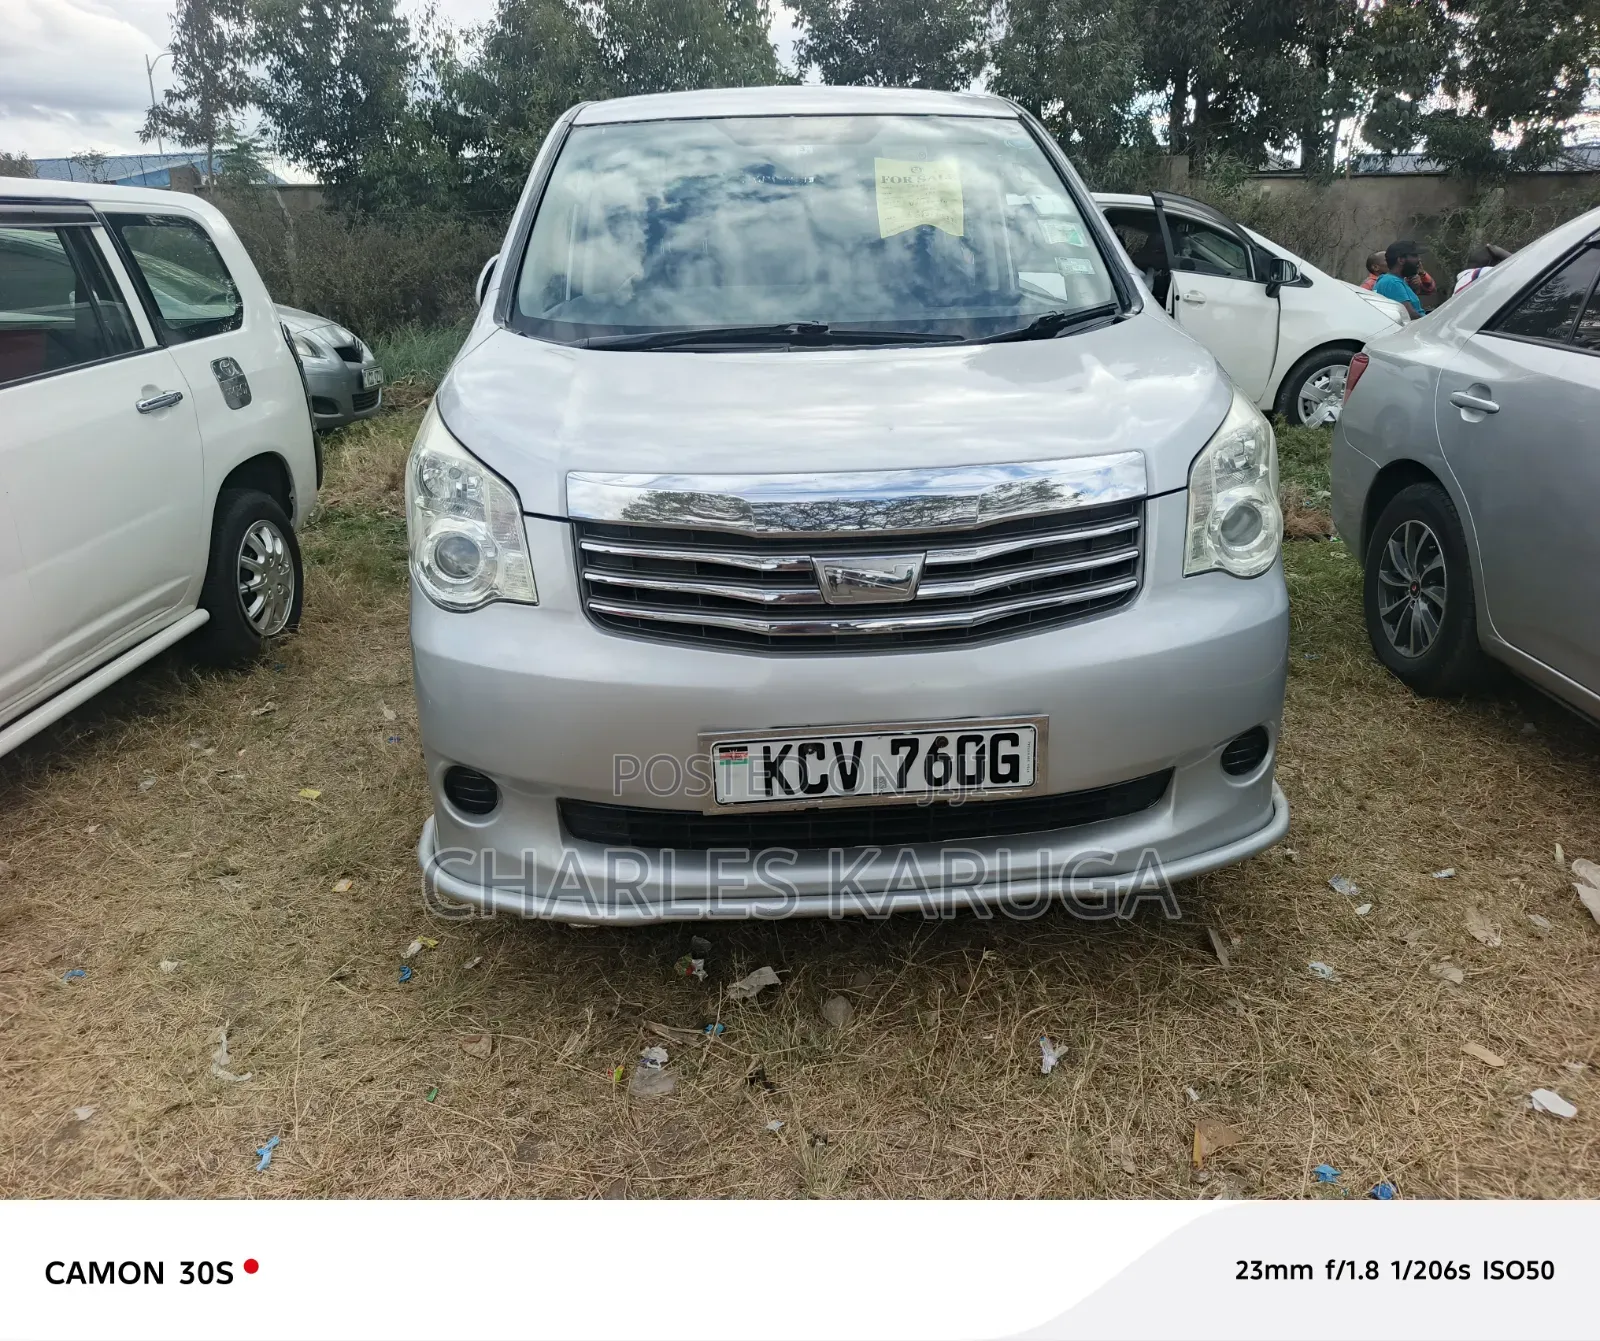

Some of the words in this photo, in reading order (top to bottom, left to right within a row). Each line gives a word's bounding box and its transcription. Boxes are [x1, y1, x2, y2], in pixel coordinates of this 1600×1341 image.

[881, 175, 913, 184] FOR
[762, 740, 863, 797] KCV
[890, 732, 1020, 789] 760G
